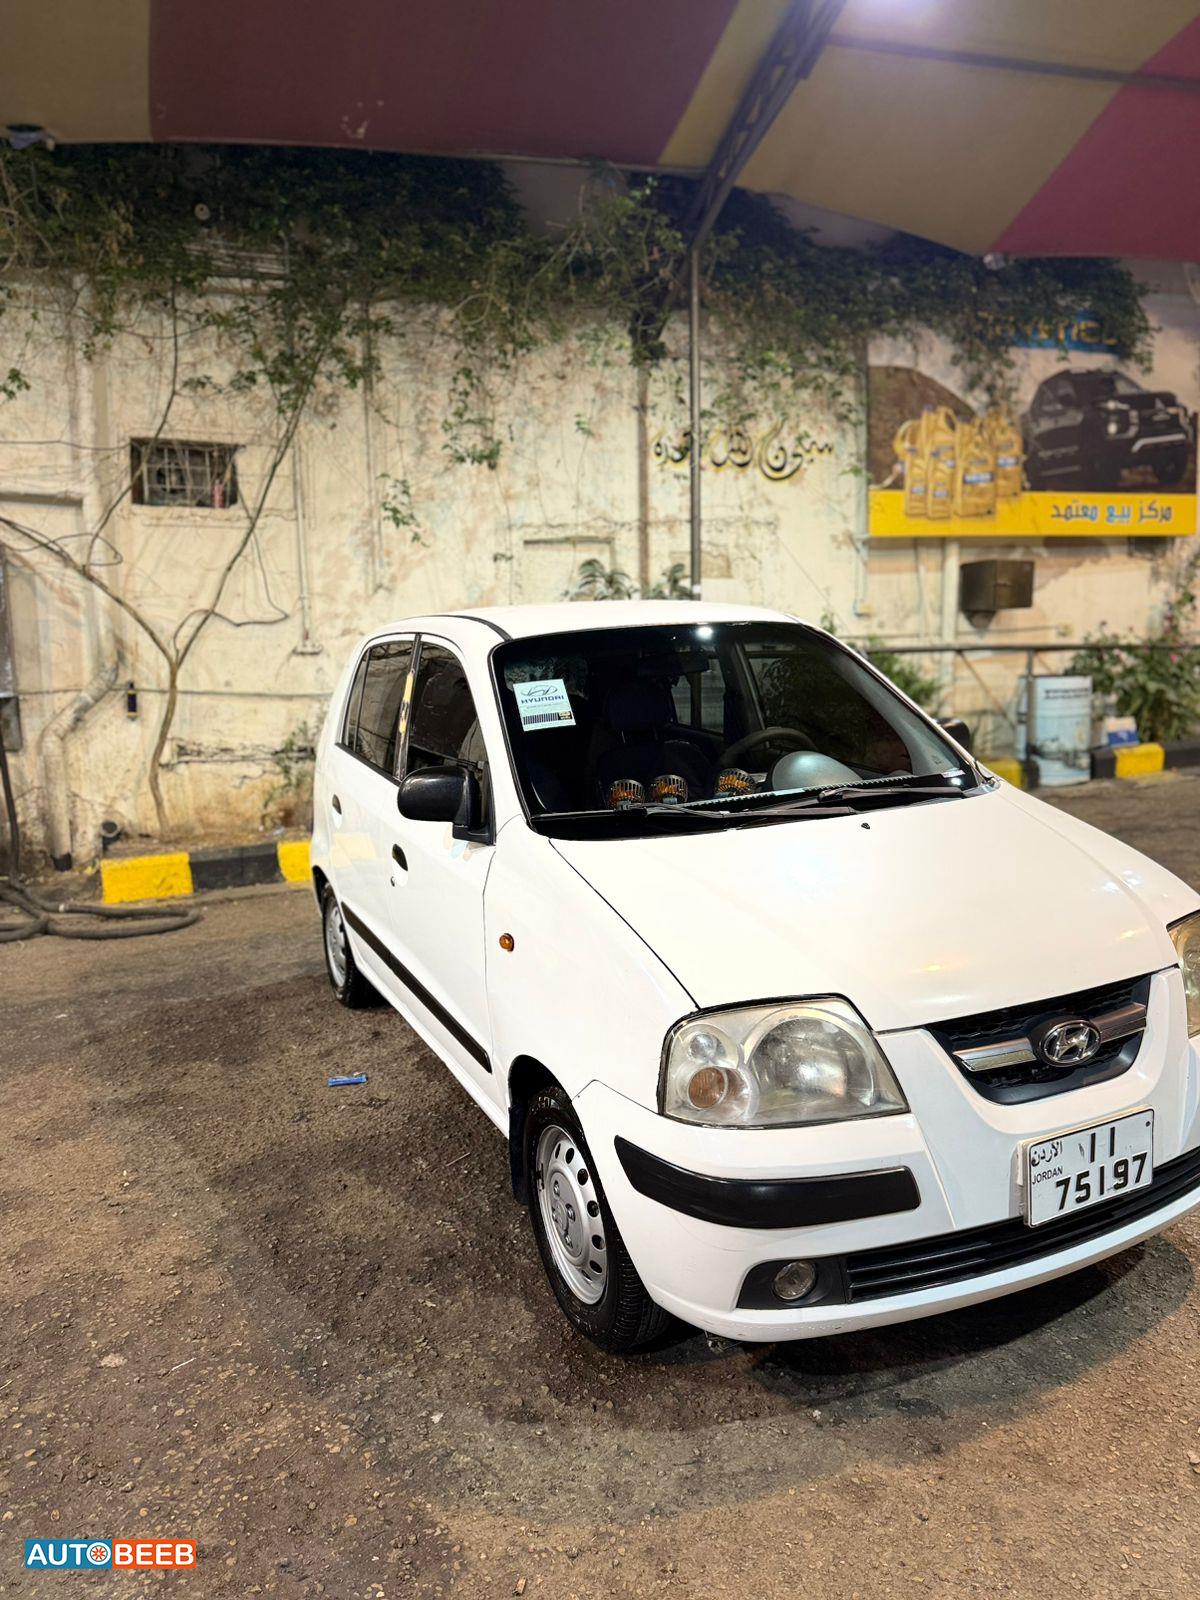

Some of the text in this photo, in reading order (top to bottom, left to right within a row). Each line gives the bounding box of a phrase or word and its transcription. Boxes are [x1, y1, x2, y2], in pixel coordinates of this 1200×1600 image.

[1051, 498, 1173, 523] مركز بيع معتمد
[521, 695, 564, 704] HYUNDAI
[1089, 1126, 1116, 1163] 11
[1032, 1166, 1063, 1185] JORDAN
[1055, 1152, 1148, 1211] 75197
